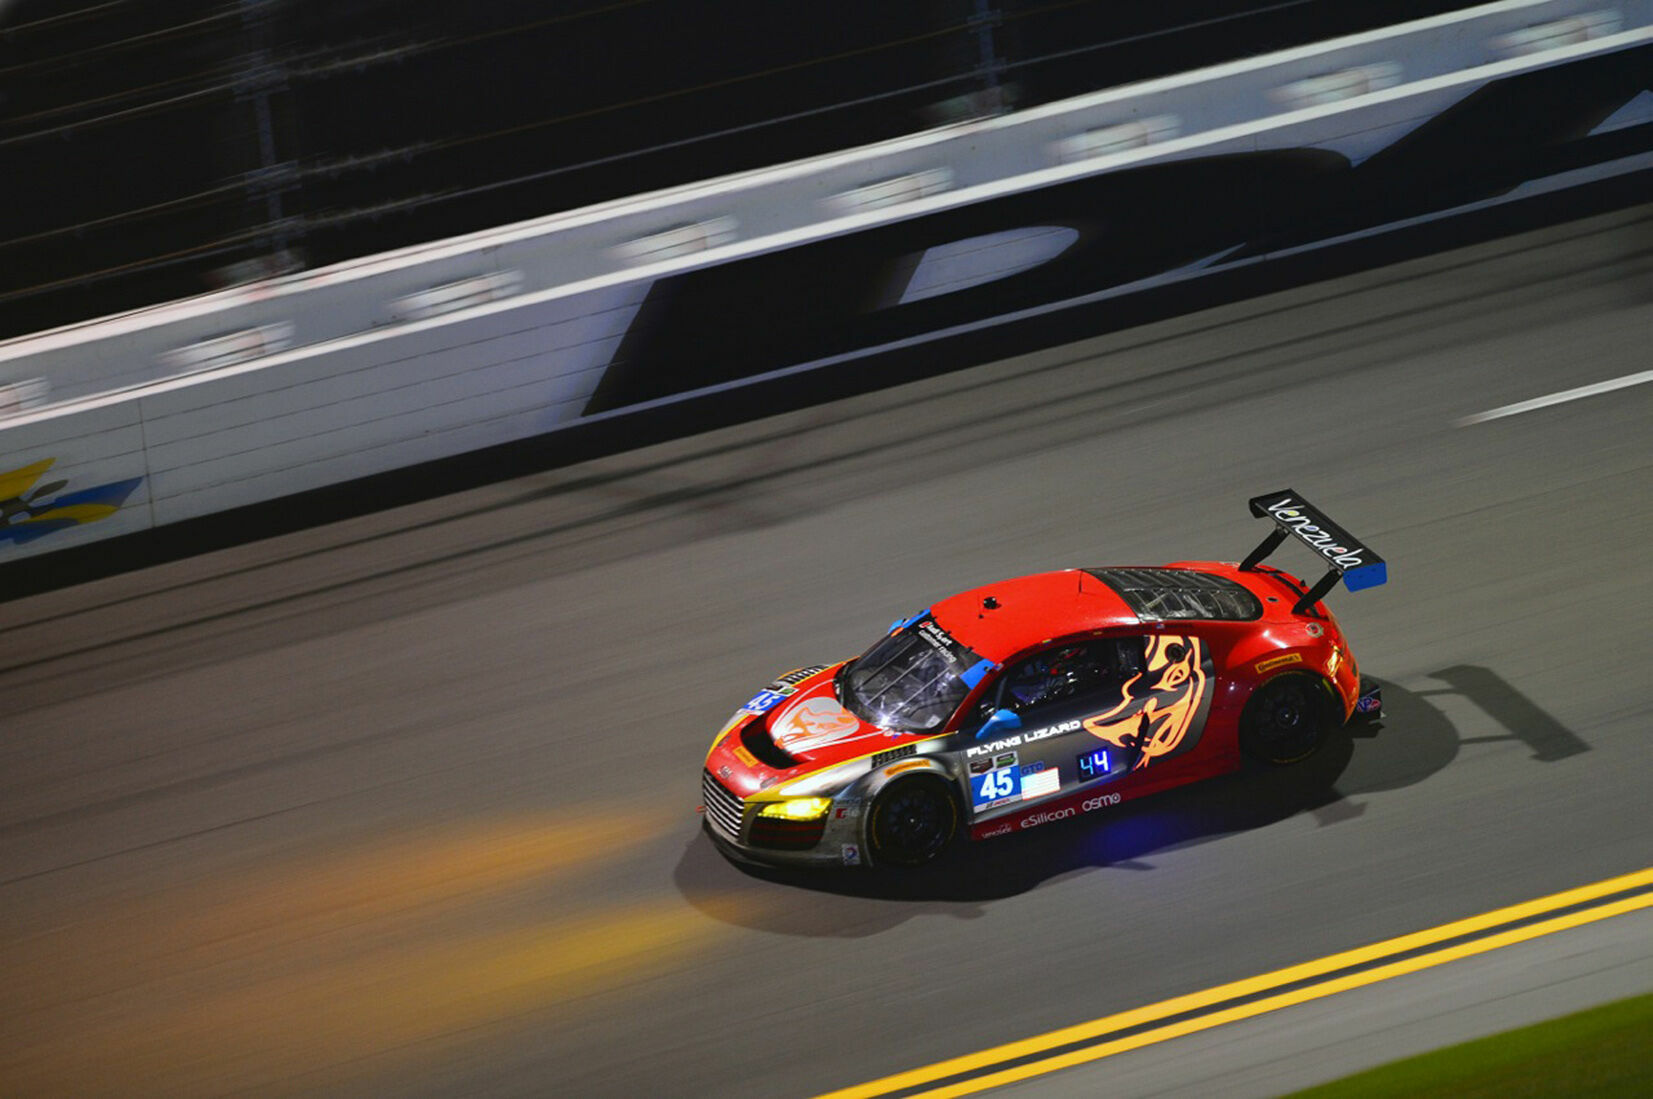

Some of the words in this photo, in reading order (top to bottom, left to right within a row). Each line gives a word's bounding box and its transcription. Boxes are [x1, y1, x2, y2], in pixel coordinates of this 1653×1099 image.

[1268, 498, 1364, 570] Venezuela
[966, 735, 1022, 758] FLYING
[1024, 720, 1081, 743] LIZARD
[1080, 750, 1109, 775] 44
[980, 767, 1014, 800] 45
[1020, 806, 1076, 829] eSilicon
[1082, 792, 1121, 812] osmo
